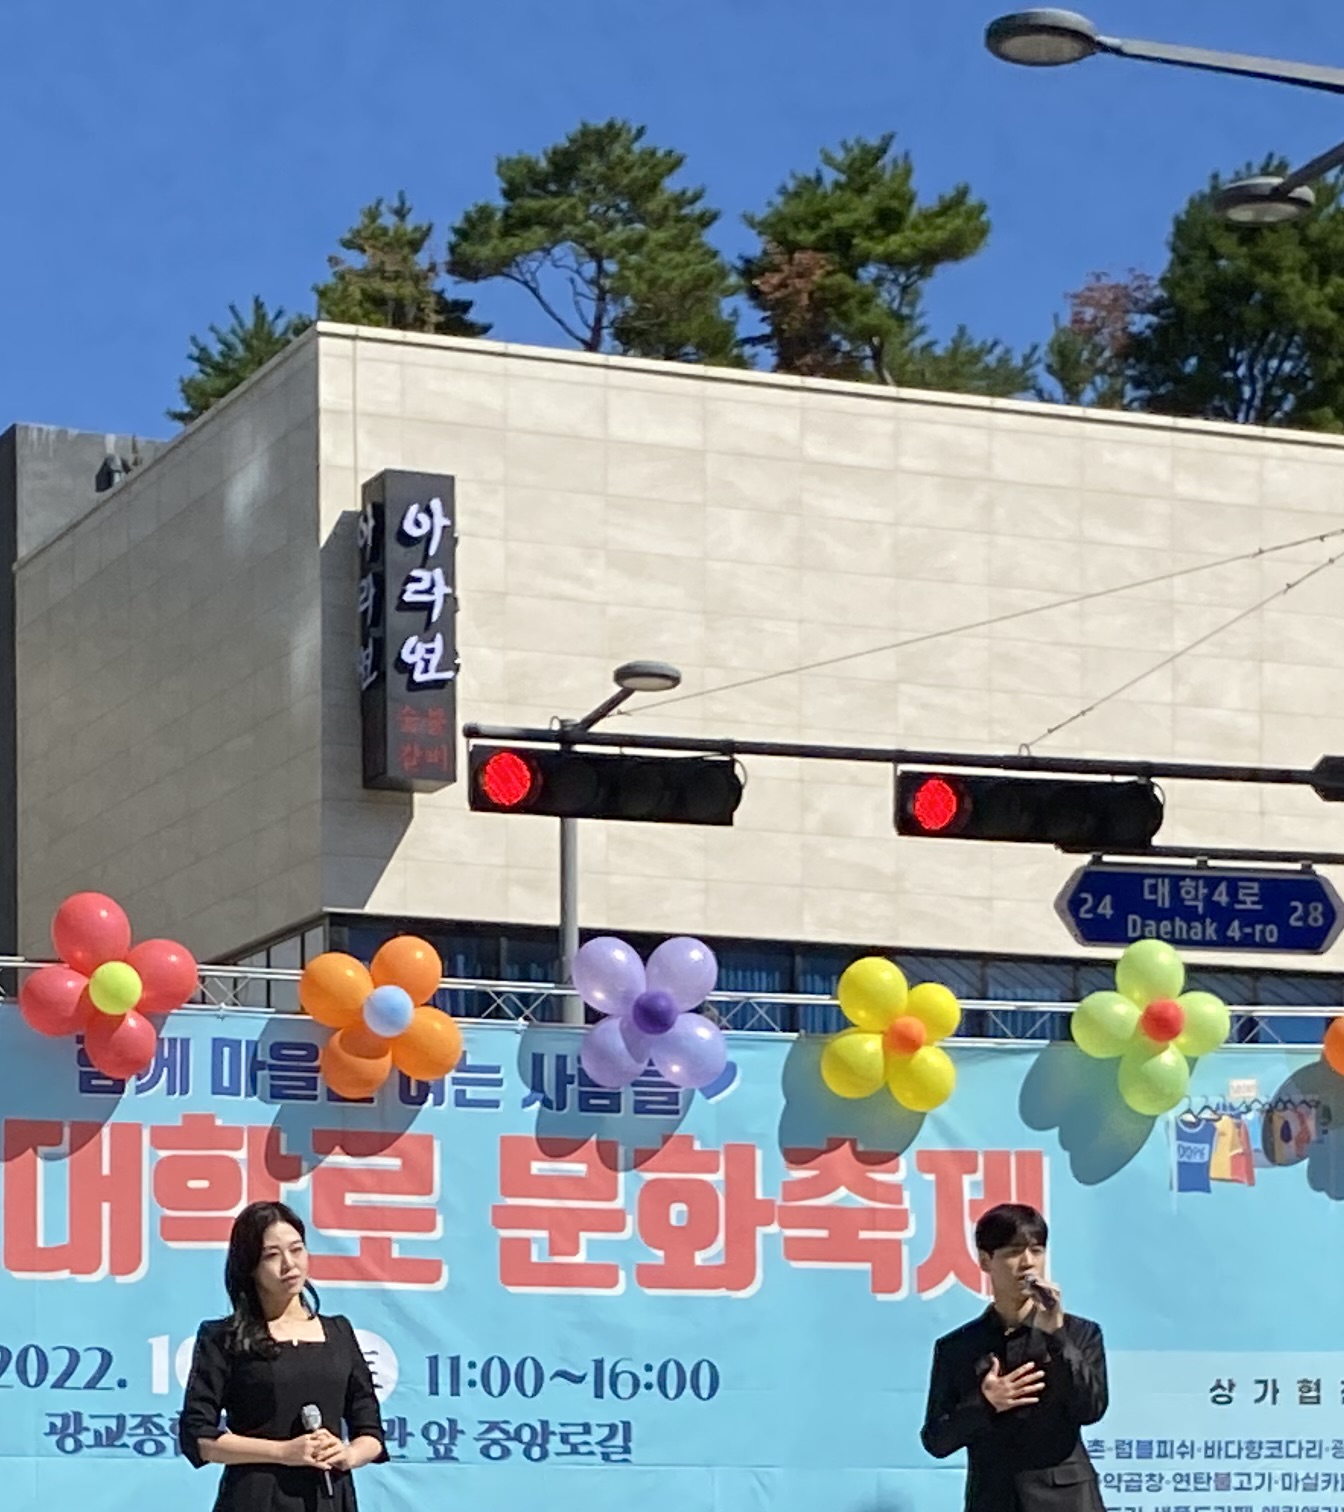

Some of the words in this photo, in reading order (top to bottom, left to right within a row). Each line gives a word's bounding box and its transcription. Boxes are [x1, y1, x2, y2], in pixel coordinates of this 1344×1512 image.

[401, 497, 457, 683] 아라연
[1078, 892, 1114, 919] 24
[1143, 878, 1264, 914] 대학4로
[1289, 902, 1324, 927] 28
[1127, 914, 1218, 941] Daehak
[1226, 919, 1278, 943] 4-ro
[491, 1133, 1050, 1299] 문화축제
[425, 1354, 720, 1401] 11:00~16:00
[421, 1417, 465, 1463] 앞
[474, 1418, 633, 1464] 중앙로길
